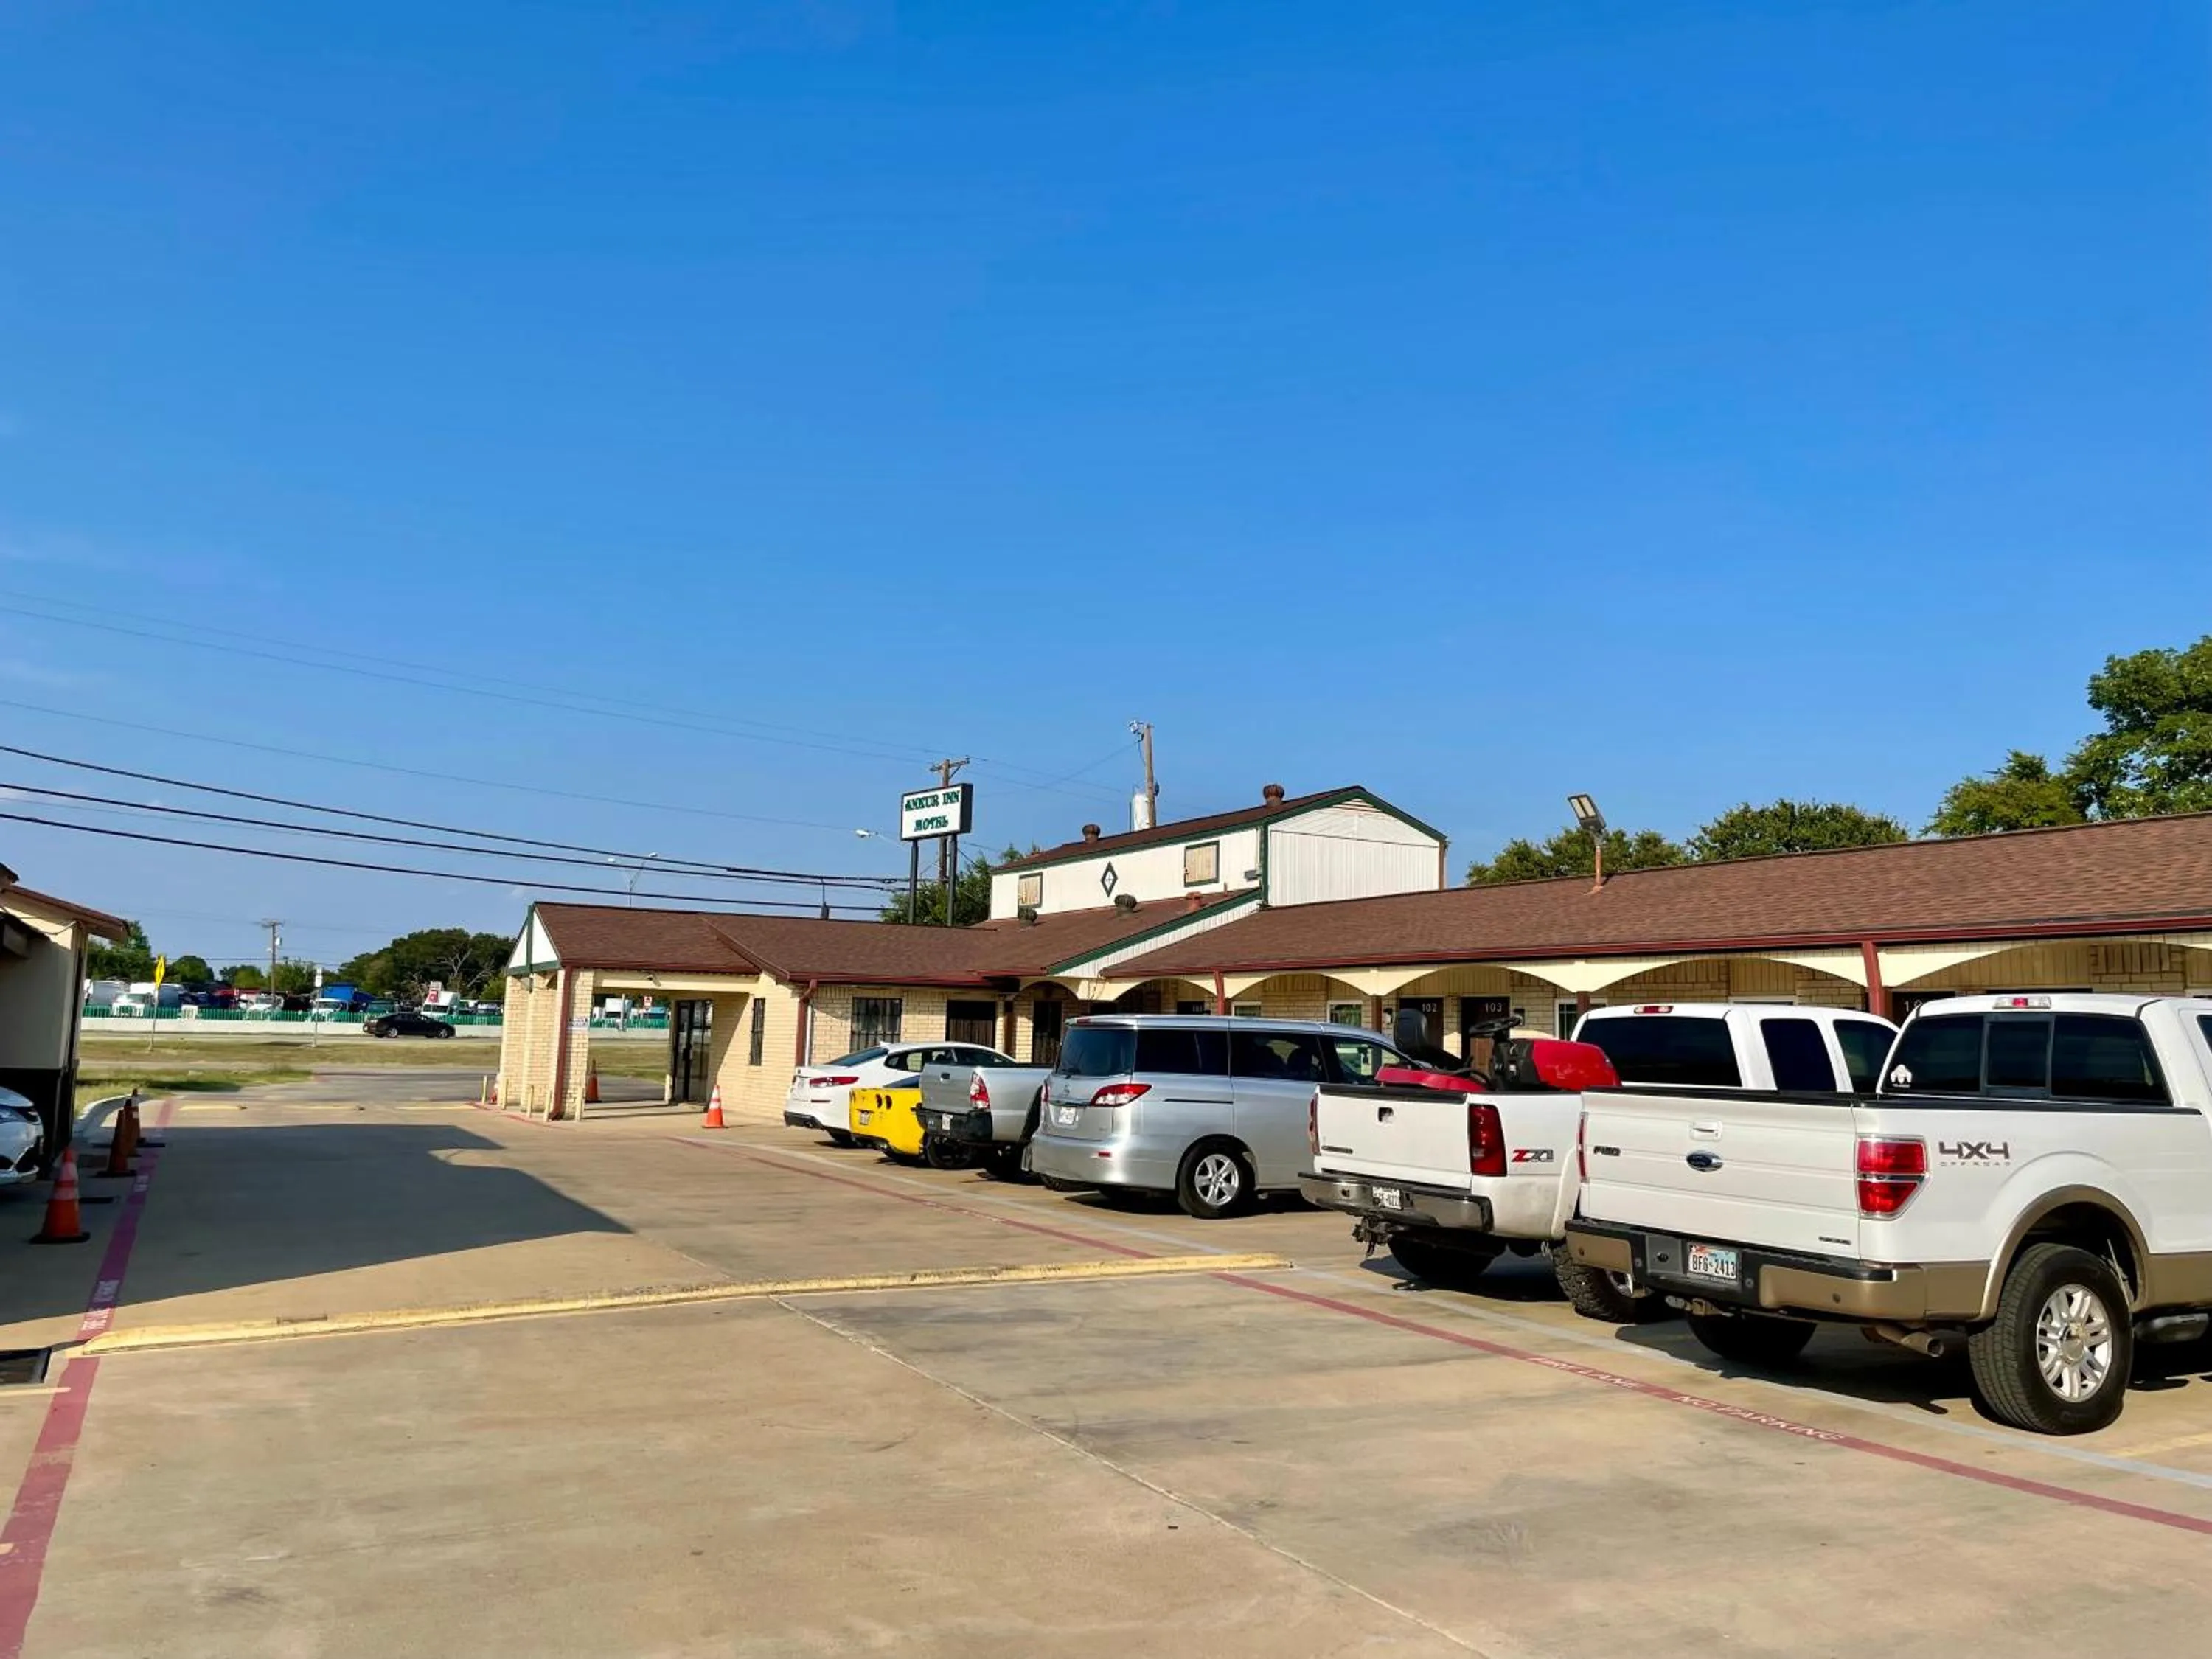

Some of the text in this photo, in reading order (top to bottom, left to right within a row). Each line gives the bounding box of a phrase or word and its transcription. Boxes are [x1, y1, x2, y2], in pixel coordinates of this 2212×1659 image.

[942, 790, 960, 805] INN
[1421, 1003, 1437, 1012] 102
[1485, 1003, 1503, 1012] 103
[1716, 1405, 1845, 1441] PARKING
